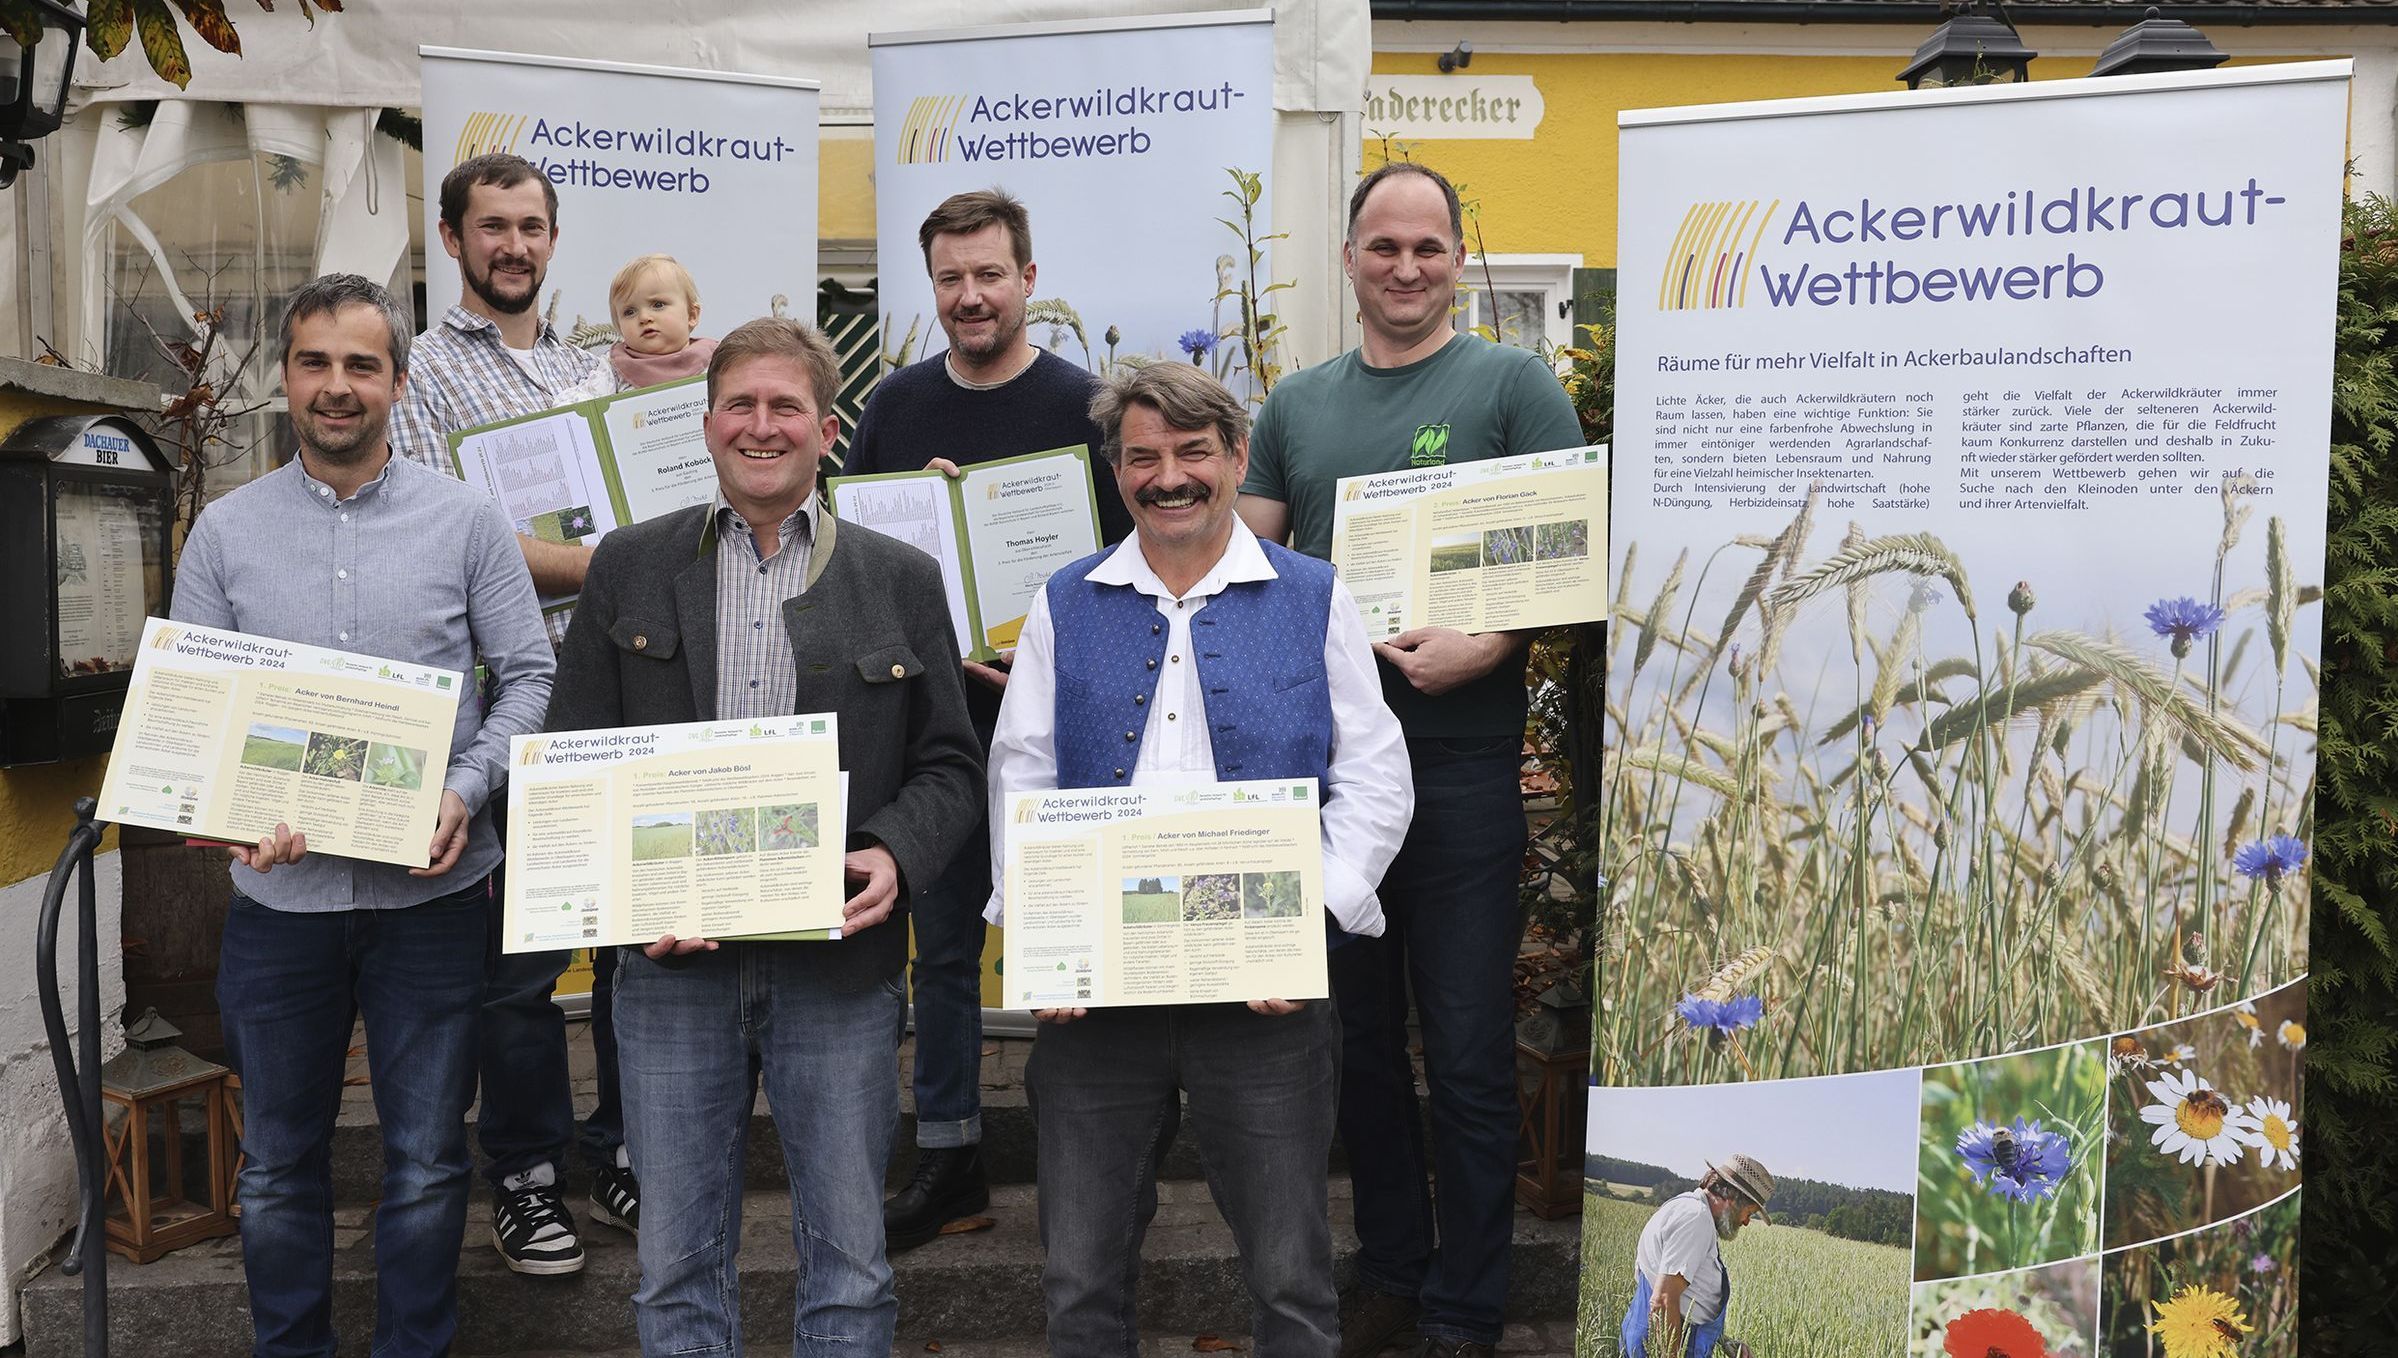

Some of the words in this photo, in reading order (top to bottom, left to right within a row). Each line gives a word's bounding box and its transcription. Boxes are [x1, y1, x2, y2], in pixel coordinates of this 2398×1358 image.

[970, 82, 1244, 122] Ackerwildkraut-
[531, 118, 795, 161] Ackerwildkraut-
[958, 127, 1151, 162] Wettbewerb
[1783, 178, 2286, 245] Ackerwildkraut-
[1761, 253, 2104, 308] Wettbewerb
[1658, 355, 1720, 371] Räume
[1724, 352, 1751, 370] für
[1756, 352, 1806, 369] mehr
[1809, 350, 1875, 368] Vielfalt
[1881, 351, 1897, 366] in
[1904, 344, 2131, 366] Ackerbaulandschaften
[1656, 395, 1686, 406] Lichte
[1695, 393, 1726, 406] Äcker,
[1735, 394, 1751, 405] die
[1760, 393, 1786, 405] auch
[1796, 392, 1896, 404] Ackerwildkräutern
[1906, 391, 1933, 402] noch
[1962, 390, 1988, 403] geht
[2003, 390, 2020, 401] die
[2034, 389, 2072, 401] Vielfalt
[2086, 389, 2106, 400] der
[2121, 386, 2222, 400] Ackerwildkräuter
[2238, 386, 2278, 397] immer
[1656, 410, 1684, 420] Raum
[1692, 409, 1725, 423] lassen,
[1733, 407, 1766, 419] haben
[1773, 409, 1796, 419] eine
[1804, 406, 1850, 422] wichtige
[1858, 407, 1910, 419] Funktion:
[1916, 407, 1933, 417] Sie
[1963, 404, 2000, 417] stärker
[2012, 404, 2052, 416] zurück.
[2064, 403, 2091, 415] Viele
[2104, 404, 2124, 415] der
[2137, 402, 2198, 415] selteneren
[2212, 402, 2276, 414] Ackerwild-
[1655, 423, 1676, 435] sind
[1682, 422, 1708, 435] nicht
[1715, 426, 1733, 435] nur
[1740, 424, 1762, 433] eine
[1770, 422, 1833, 434] farbenfrohe
[1840, 421, 1914, 435] Abwechslung
[1922, 422, 1932, 432] in
[1962, 419, 2002, 431] kräuter
[2009, 421, 2032, 431] sind
[2040, 422, 2068, 432] zarte
[2076, 419, 2128, 434] Pflanzen,
[2136, 419, 2154, 430] die
[2162, 419, 2180, 430] für
[2188, 419, 2206, 430] die
[2215, 418, 2276, 430] Feldfrucht
[84, 433, 130, 452] DACHAUER
[1654, 439, 1688, 450] immer
[1701, 437, 1755, 452] eintöniger
[1769, 436, 1830, 449] werdenden
[1845, 437, 1932, 449] Agrarlandschaf-
[1961, 436, 1992, 447] kaum
[2000, 435, 2064, 447] Konkurrenz
[2071, 435, 2126, 447] darstellen
[2134, 435, 2158, 446] und
[2166, 435, 2213, 446] deshalb
[2221, 435, 2232, 445] in
[2240, 435, 2275, 446] Zuku-
[96, 450, 118, 465] BIER
[1654, 452, 1673, 464] ten,
[1681, 453, 1724, 464] sondern
[1733, 451, 1766, 464] bieten
[1776, 451, 1842, 463] Lebensraum
[1852, 453, 1873, 463] und
[1883, 451, 1931, 465] Nahrung
[1961, 451, 1976, 462] nft
[1978, 452, 2017, 463] wieder
[2019, 452, 2057, 463] stärker
[2059, 450, 2113, 466] gefördert
[2115, 451, 2159, 462] werden
[2161, 451, 2204, 462] sollten.
[657, 463, 683, 474] Roland
[1653, 467, 1668, 478] für
[1670, 468, 1692, 478] eine
[1693, 466, 1733, 478] Vielzahl
[1736, 466, 1794, 478] heimischer
[1796, 467, 1874, 478] Insektenarten.
[1960, 467, 1979, 478] Mit
[1990, 470, 2040, 478] unserem
[2052, 466, 2126, 478] Wettbewerb
[2138, 467, 2176, 480] gehen
[2190, 467, 2209, 478] wir
[2222, 467, 2242, 479] auf
[2254, 467, 2274, 479] die
[1368, 471, 1456, 488] Ackerwildkraut-
[1000, 485, 1043, 498] Wettbewerb
[1363, 485, 1426, 499] Wettbewerb
[1431, 481, 1452, 489] 2024
[1653, 482, 1682, 493] Durch
[1694, 481, 1766, 495] Intensivierung
[1778, 482, 1796, 493] der
[1809, 481, 1886, 493] Landwirtschaft
[1899, 481, 1930, 496] (hohe
[1960, 482, 1994, 494] Suche
[2005, 483, 2033, 493] nach
[2044, 483, 2066, 494] den
[2078, 483, 2138, 494] Kleinoden
[2150, 484, 2183, 494] unter
[2194, 483, 2218, 494] den
[2230, 481, 2273, 495] Äckern
[1653, 496, 1712, 509] N-Düngung,
[1729, 496, 1810, 511] Herbizideinsatz,
[1827, 497, 1854, 509] hohe
[1872, 496, 1929, 511] Saatstärke)
[1959, 498, 1982, 508] und
[1984, 498, 2012, 509] ihrer
[2014, 498, 2088, 510] Artenvielfalt.
[1006, 538, 1034, 547] Thomas
[1034, 533, 1059, 543] Hoyler
[184, 631, 293, 658] Ackerwildkraut-
[176, 643, 254, 665] Wettbewerb
[259, 657, 286, 669] 2024
[295, 688, 318, 698] Acker
[320, 692, 334, 701] von
[336, 694, 373, 707] Bernhard
[374, 701, 400, 712] Heindl
[550, 732, 660, 750] Ackerwildkraut-
[544, 749, 623, 764] Wettbewerb
[629, 747, 654, 756] 2024
[668, 769, 691, 777] Acker
[708, 766, 732, 774] Jakob
[734, 764, 751, 772] Bösl
[1042, 794, 1147, 808] Ackerwildkraut-
[1037, 810, 1112, 823] Wettbewerb
[1117, 809, 1142, 817] 2024
[1157, 832, 1180, 840] Acker
[1197, 830, 1228, 838] Michael
[1230, 828, 1270, 838] Friedinger
